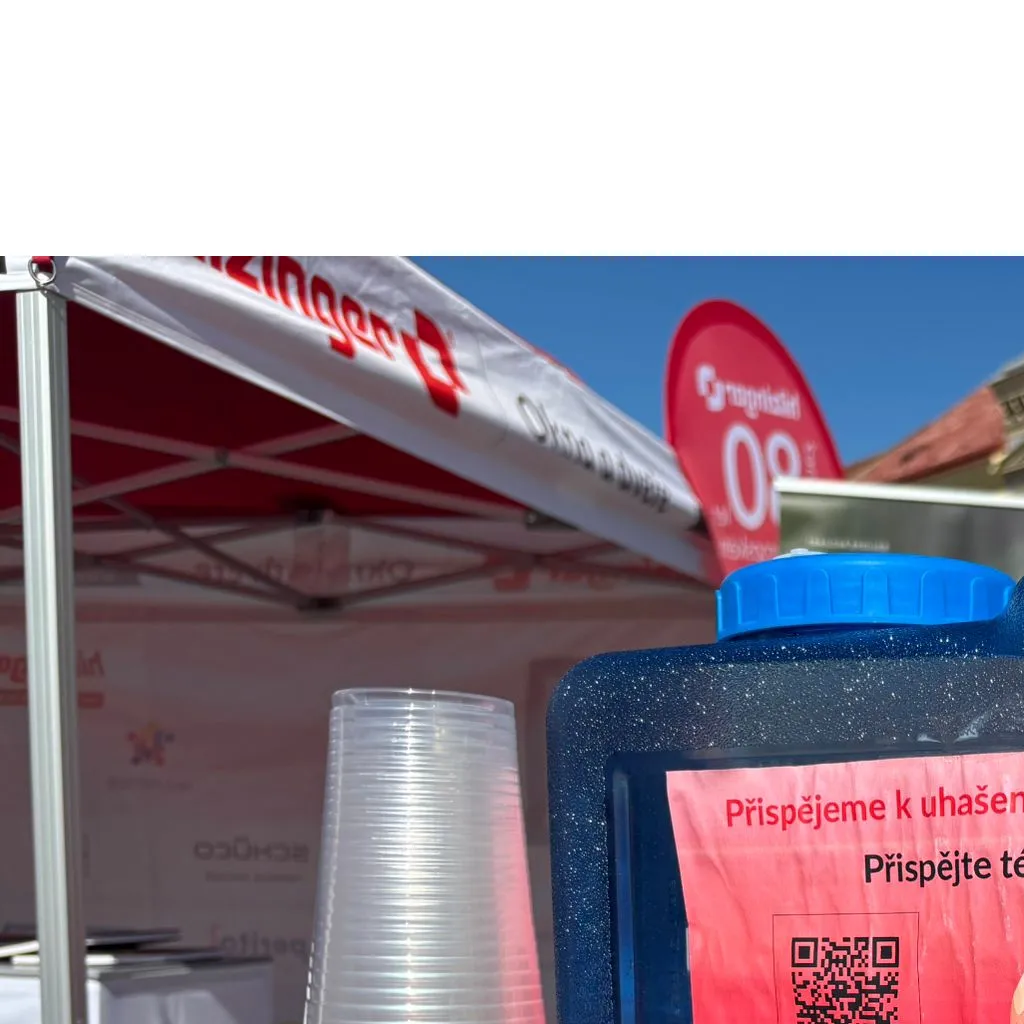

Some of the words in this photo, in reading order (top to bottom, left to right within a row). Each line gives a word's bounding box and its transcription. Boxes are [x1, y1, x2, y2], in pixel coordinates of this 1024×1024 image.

[194, 256, 398, 360] zinger
[725, 794, 886, 831] Přispějeme
[895, 789, 912, 819] k
[864, 850, 992, 888] Přispějte
